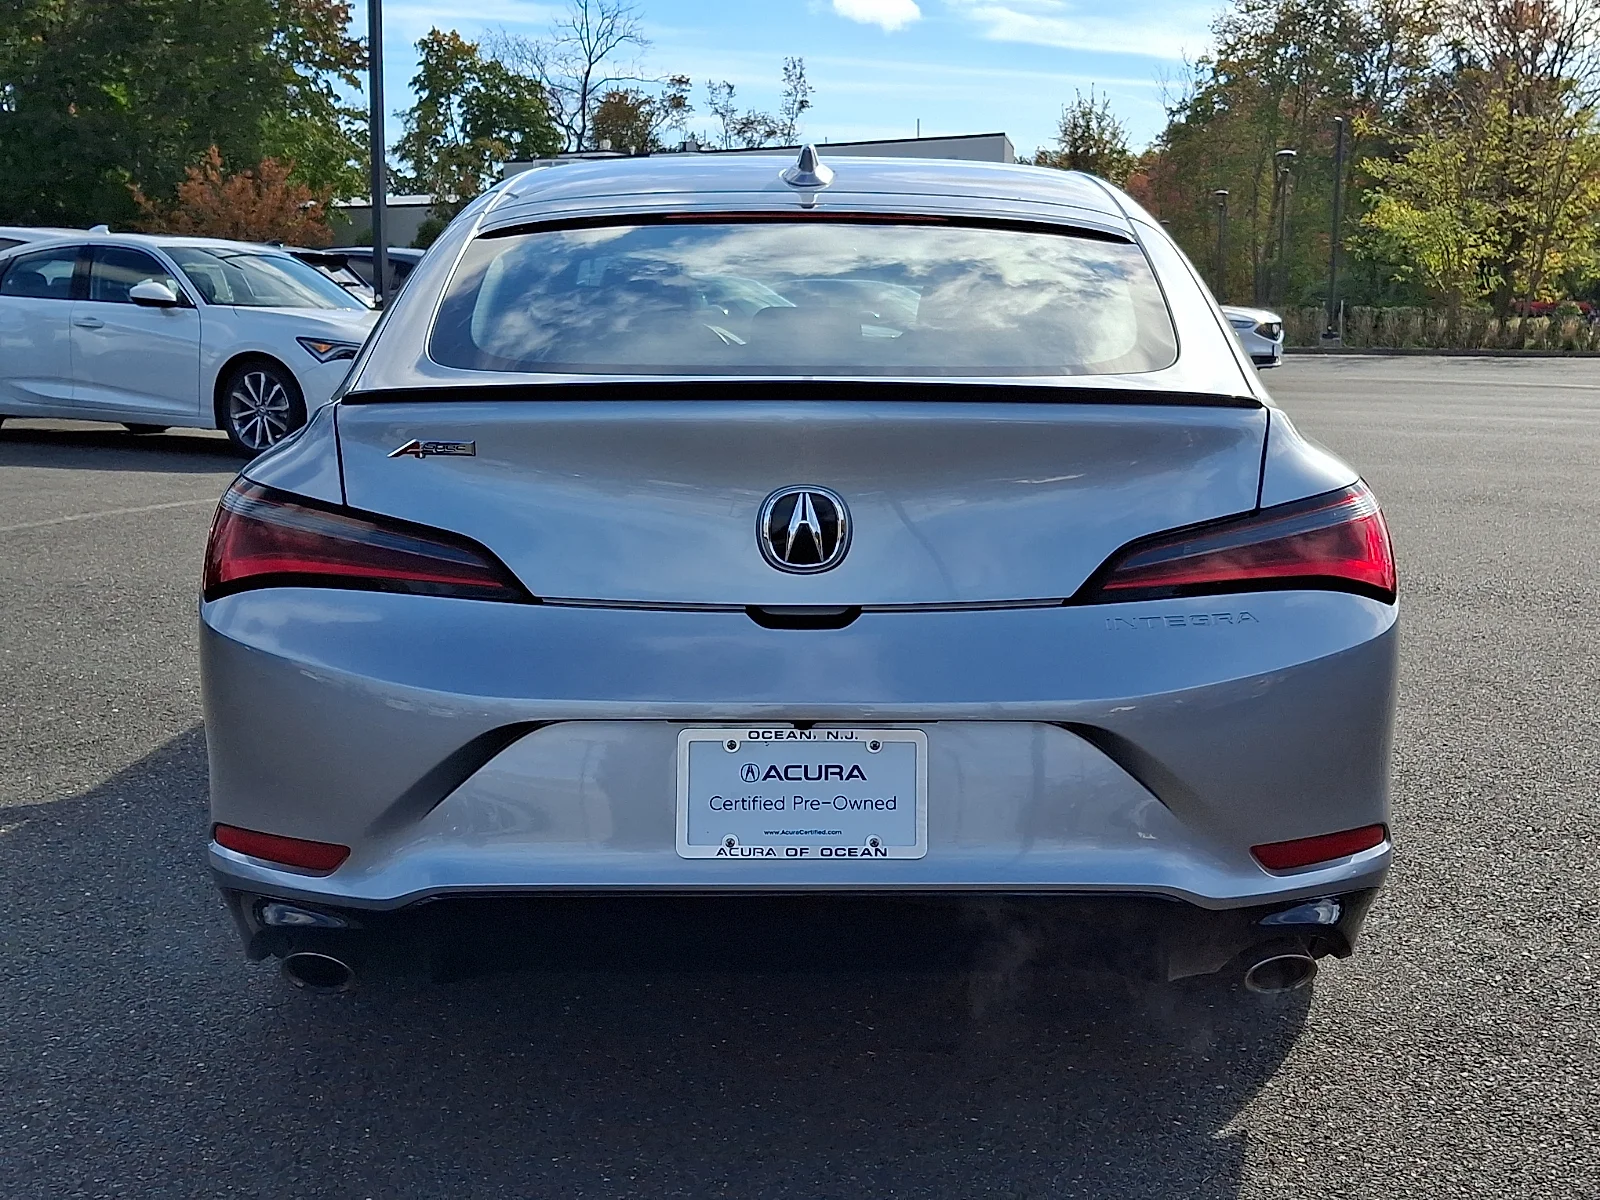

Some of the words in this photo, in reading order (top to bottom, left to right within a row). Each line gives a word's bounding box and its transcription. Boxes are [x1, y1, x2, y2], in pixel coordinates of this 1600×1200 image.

[1106, 611, 1259, 630] INTEGRA
[747, 730, 817, 741] OCEAN,
[826, 730, 859, 740] N.J.
[761, 764, 868, 782] ACURA
[709, 795, 785, 811] Certified
[792, 795, 897, 811] Pre-Owned
[763, 828, 842, 836] www.AcuraCertified.com
[716, 847, 777, 857] ACURA
[785, 847, 810, 857] OF
[820, 847, 888, 857] OCEAN
